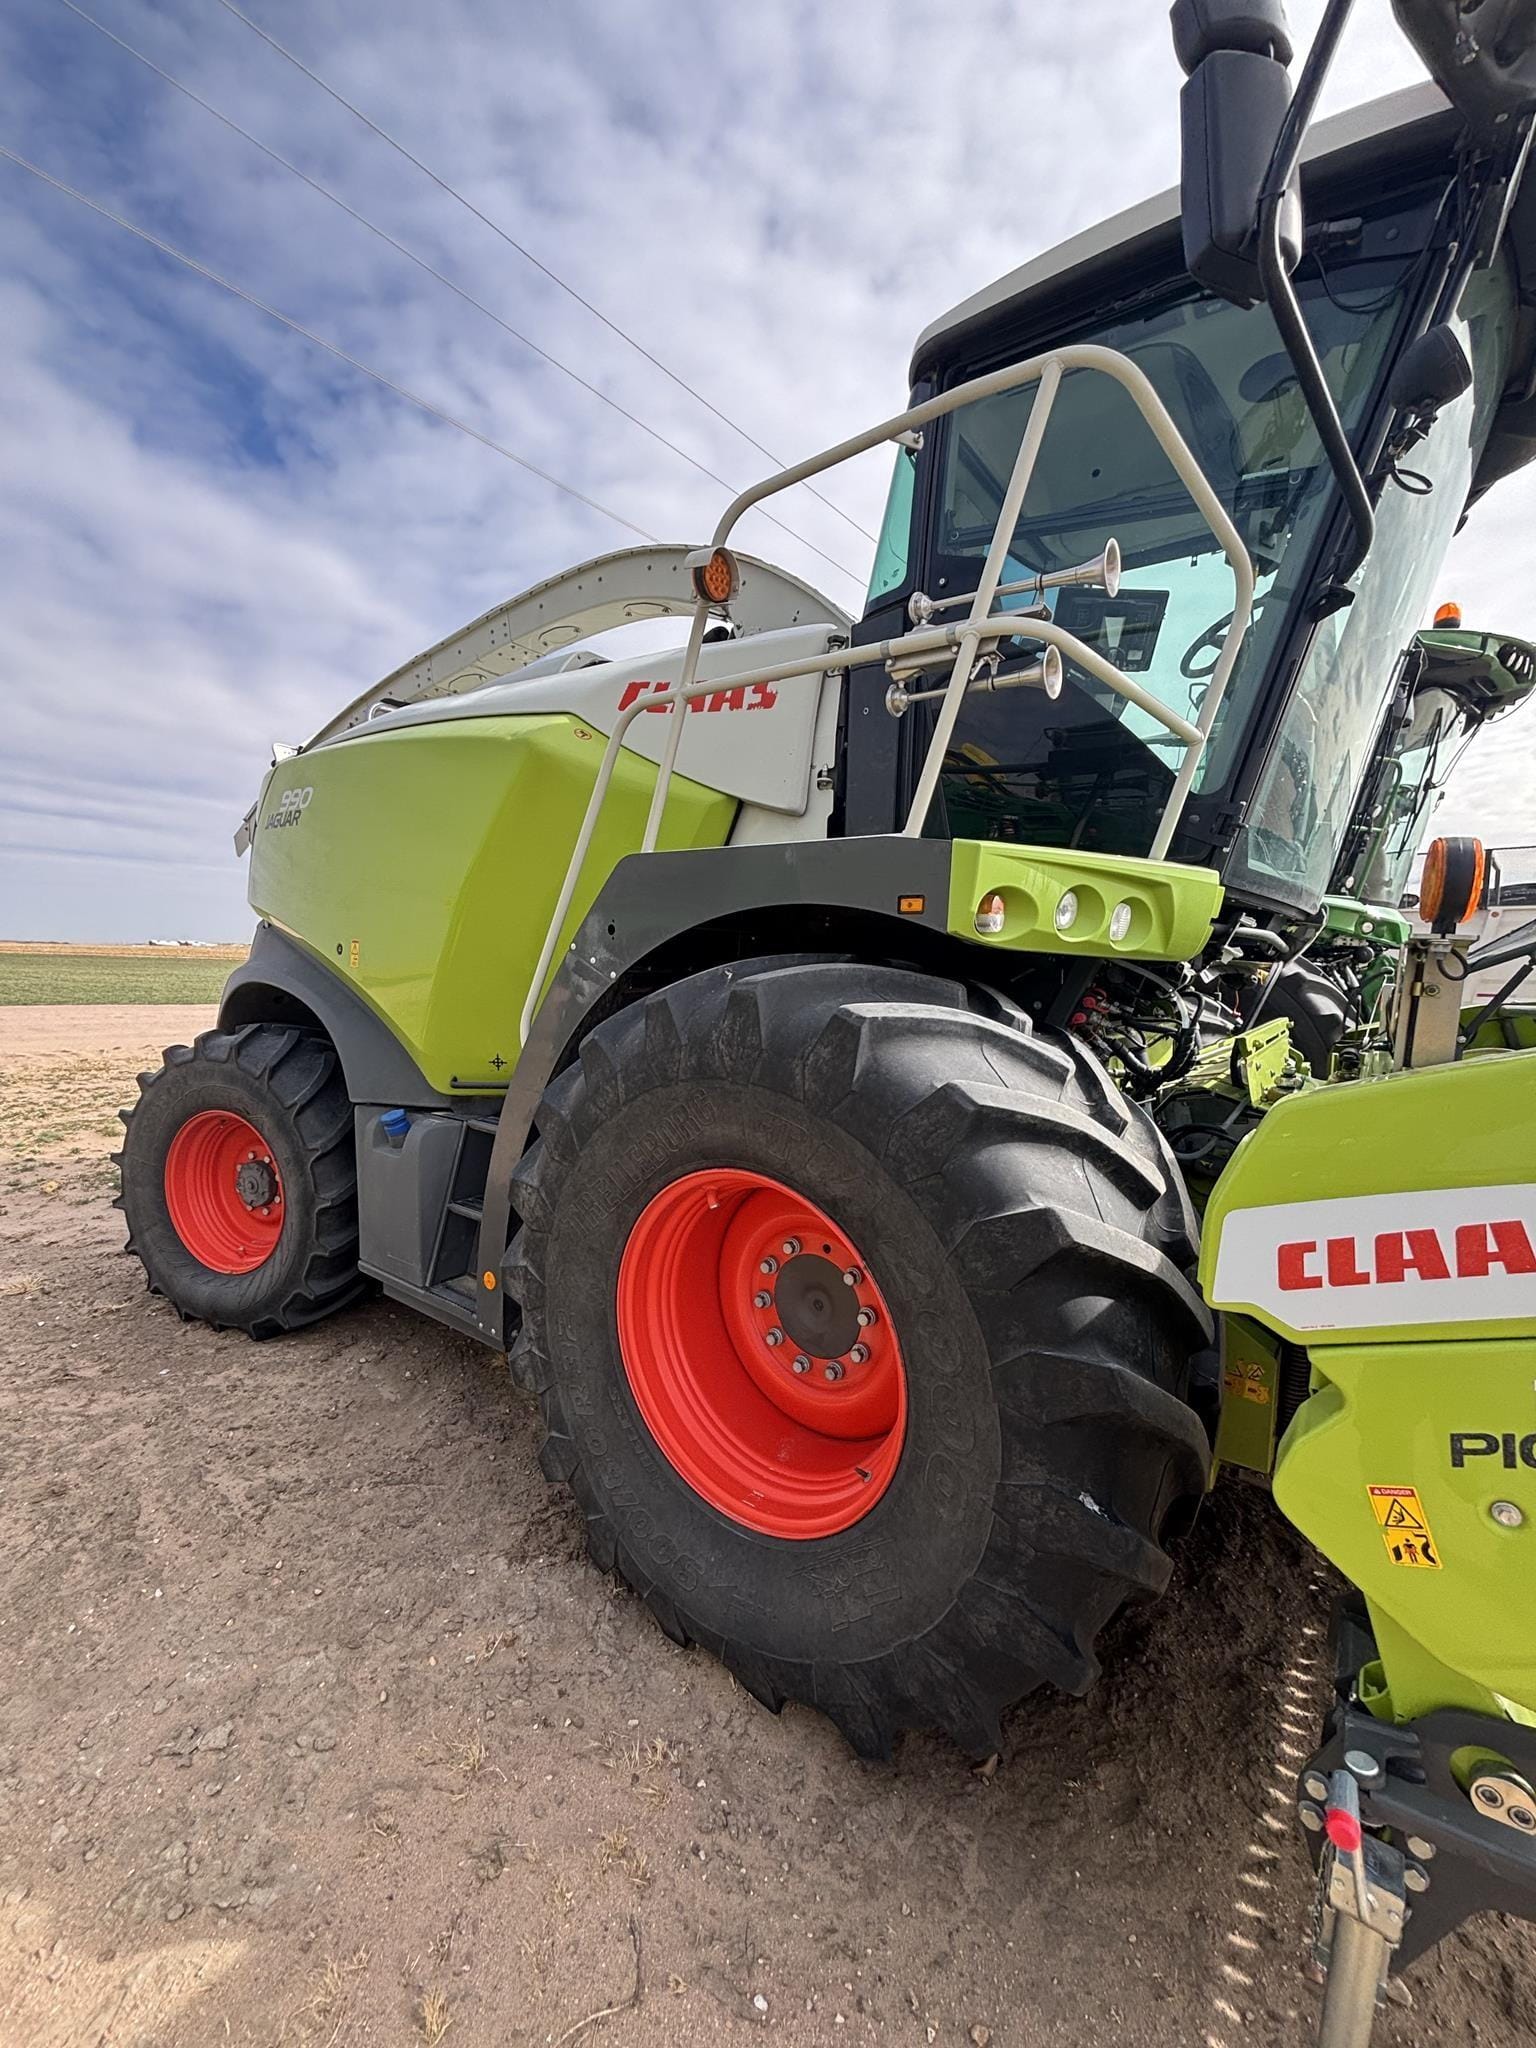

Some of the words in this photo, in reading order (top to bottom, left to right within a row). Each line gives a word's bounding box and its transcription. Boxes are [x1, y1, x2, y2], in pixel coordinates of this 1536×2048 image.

[265, 809, 301, 830] JAGUAR
[557, 1086, 717, 1240] TRELLEBORG
[1277, 1220, 1536, 1291] CLAA
[582, 1425, 704, 1593] 900/60
[1380, 1488, 1413, 1496] DANGER
